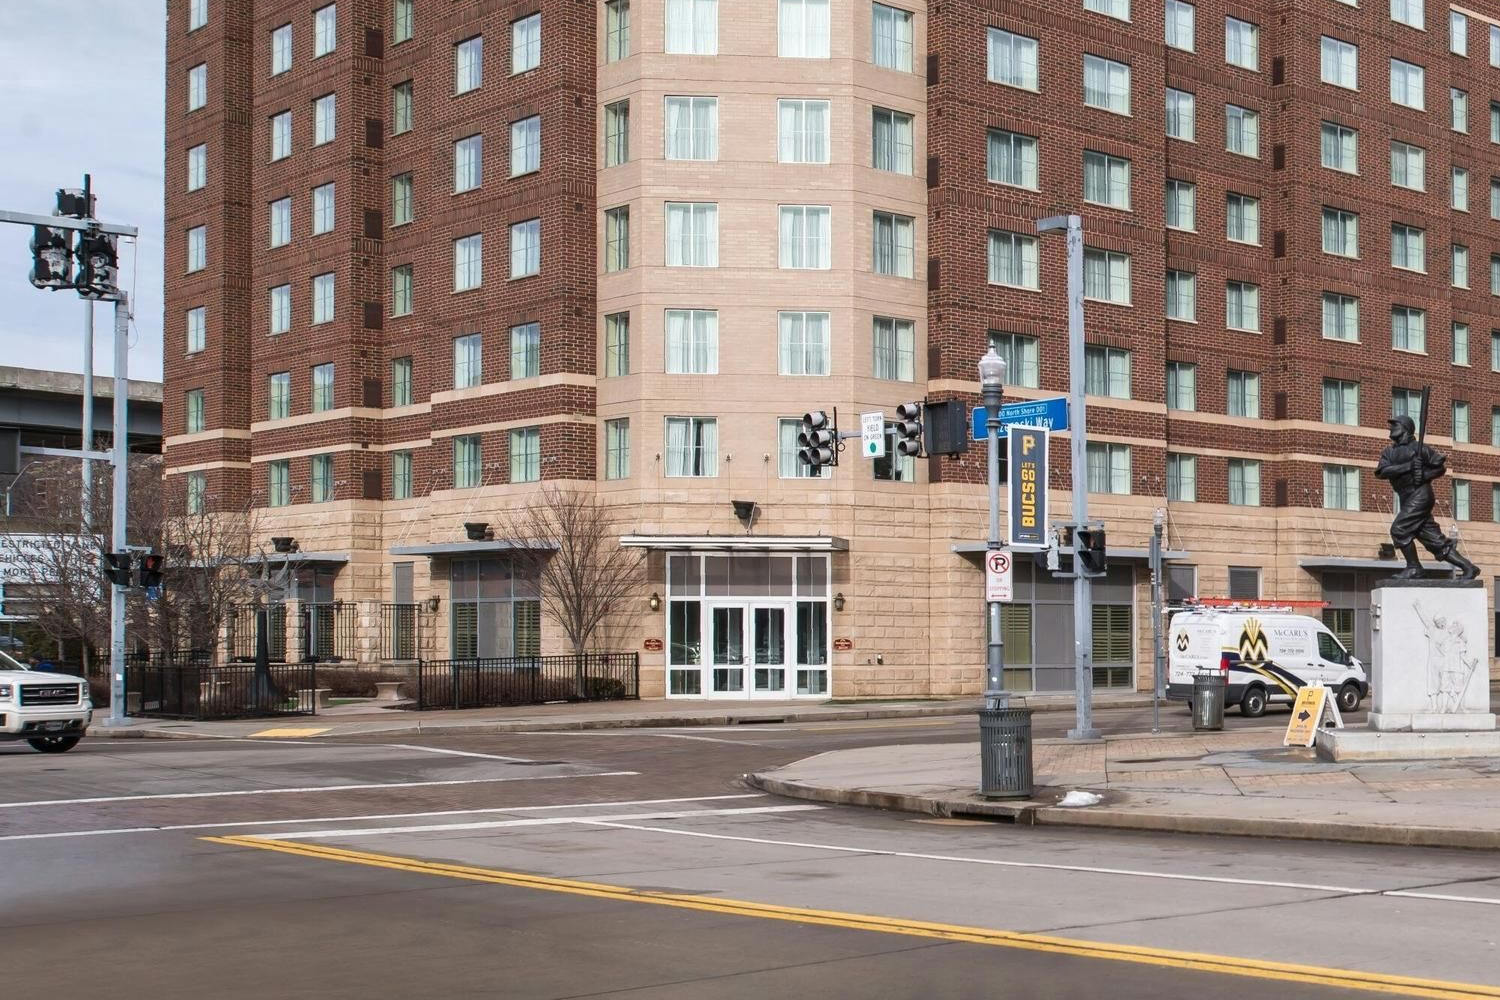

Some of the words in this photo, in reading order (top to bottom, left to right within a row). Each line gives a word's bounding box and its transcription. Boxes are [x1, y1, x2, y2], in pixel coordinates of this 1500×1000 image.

[1006, 408, 1020, 417] North
[1035, 415, 1054, 430] Way
[1021, 469, 1036, 481] GO
[1021, 482, 1036, 527] BUCS
[1, 540, 61, 549] ESTRICTED
